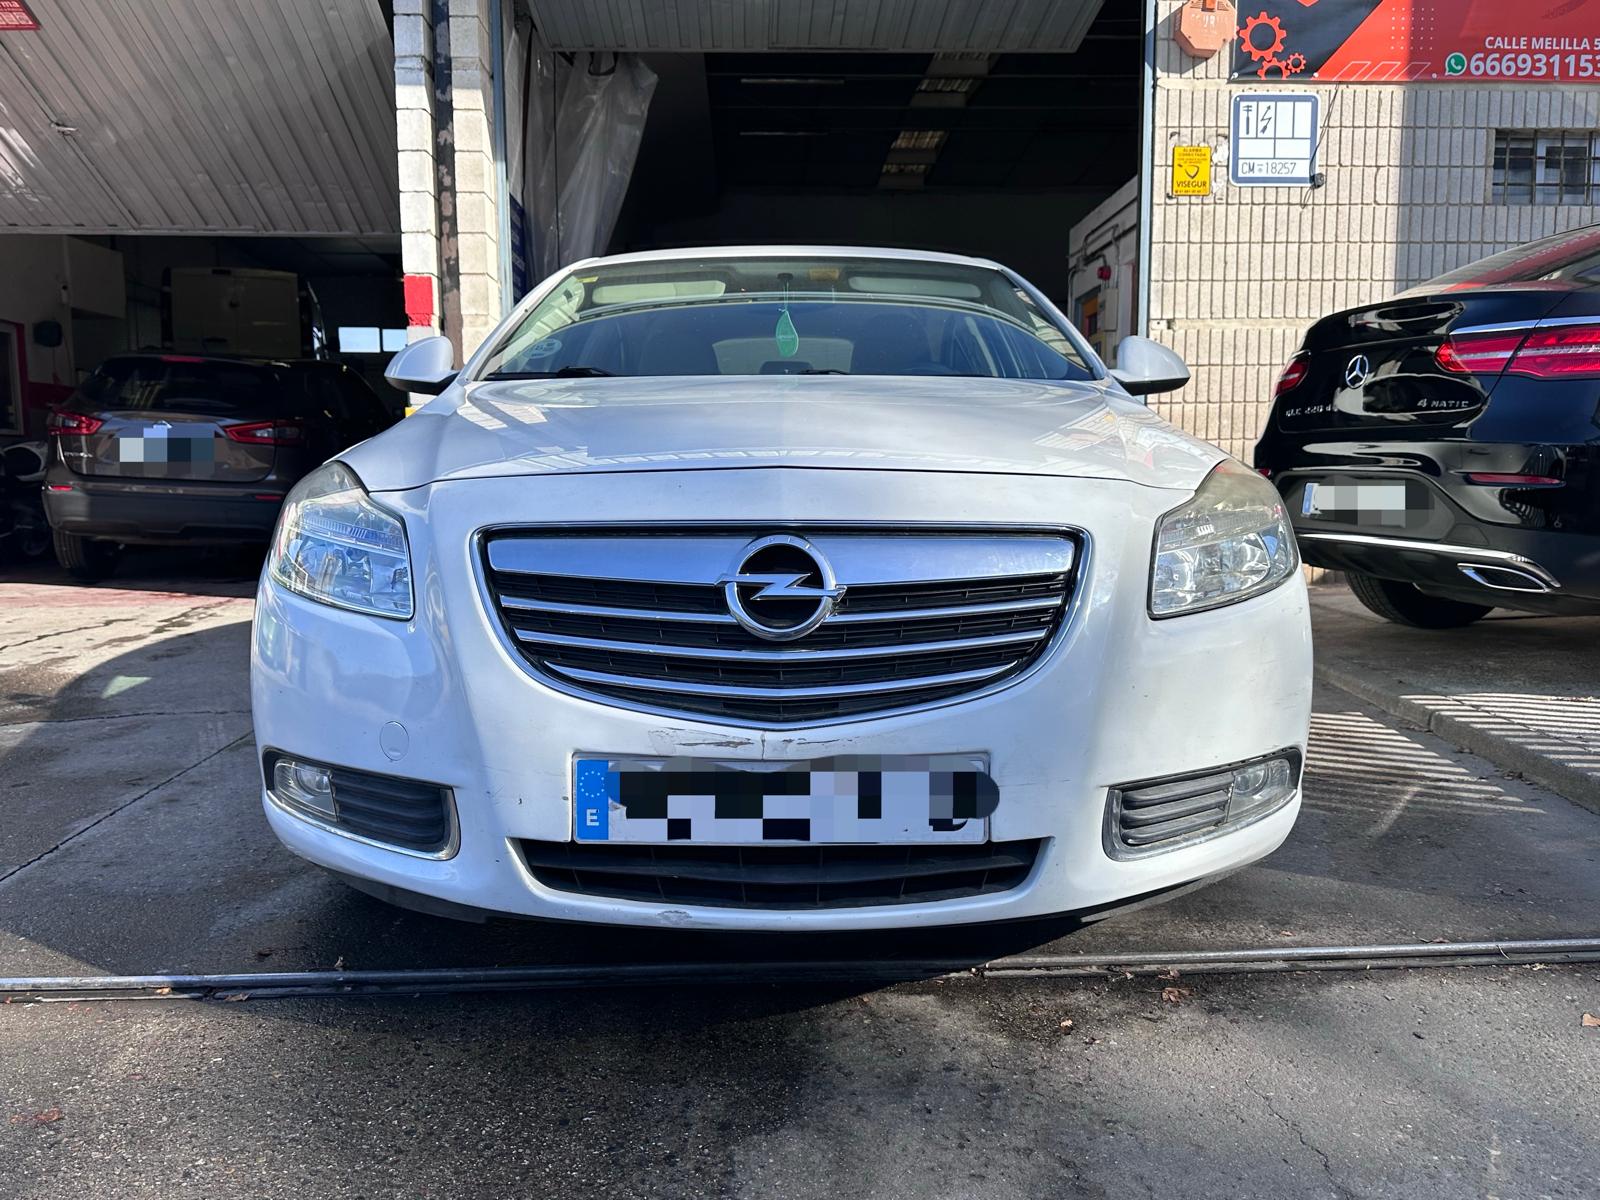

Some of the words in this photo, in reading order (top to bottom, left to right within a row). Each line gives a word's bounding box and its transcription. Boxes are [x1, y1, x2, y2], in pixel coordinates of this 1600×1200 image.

[1485, 36, 1527, 49] CALLE
[1531, 37, 1590, 50] MELILLA
[1176, 180, 1207, 188] VISEGUR
[586, 808, 600, 826] E
